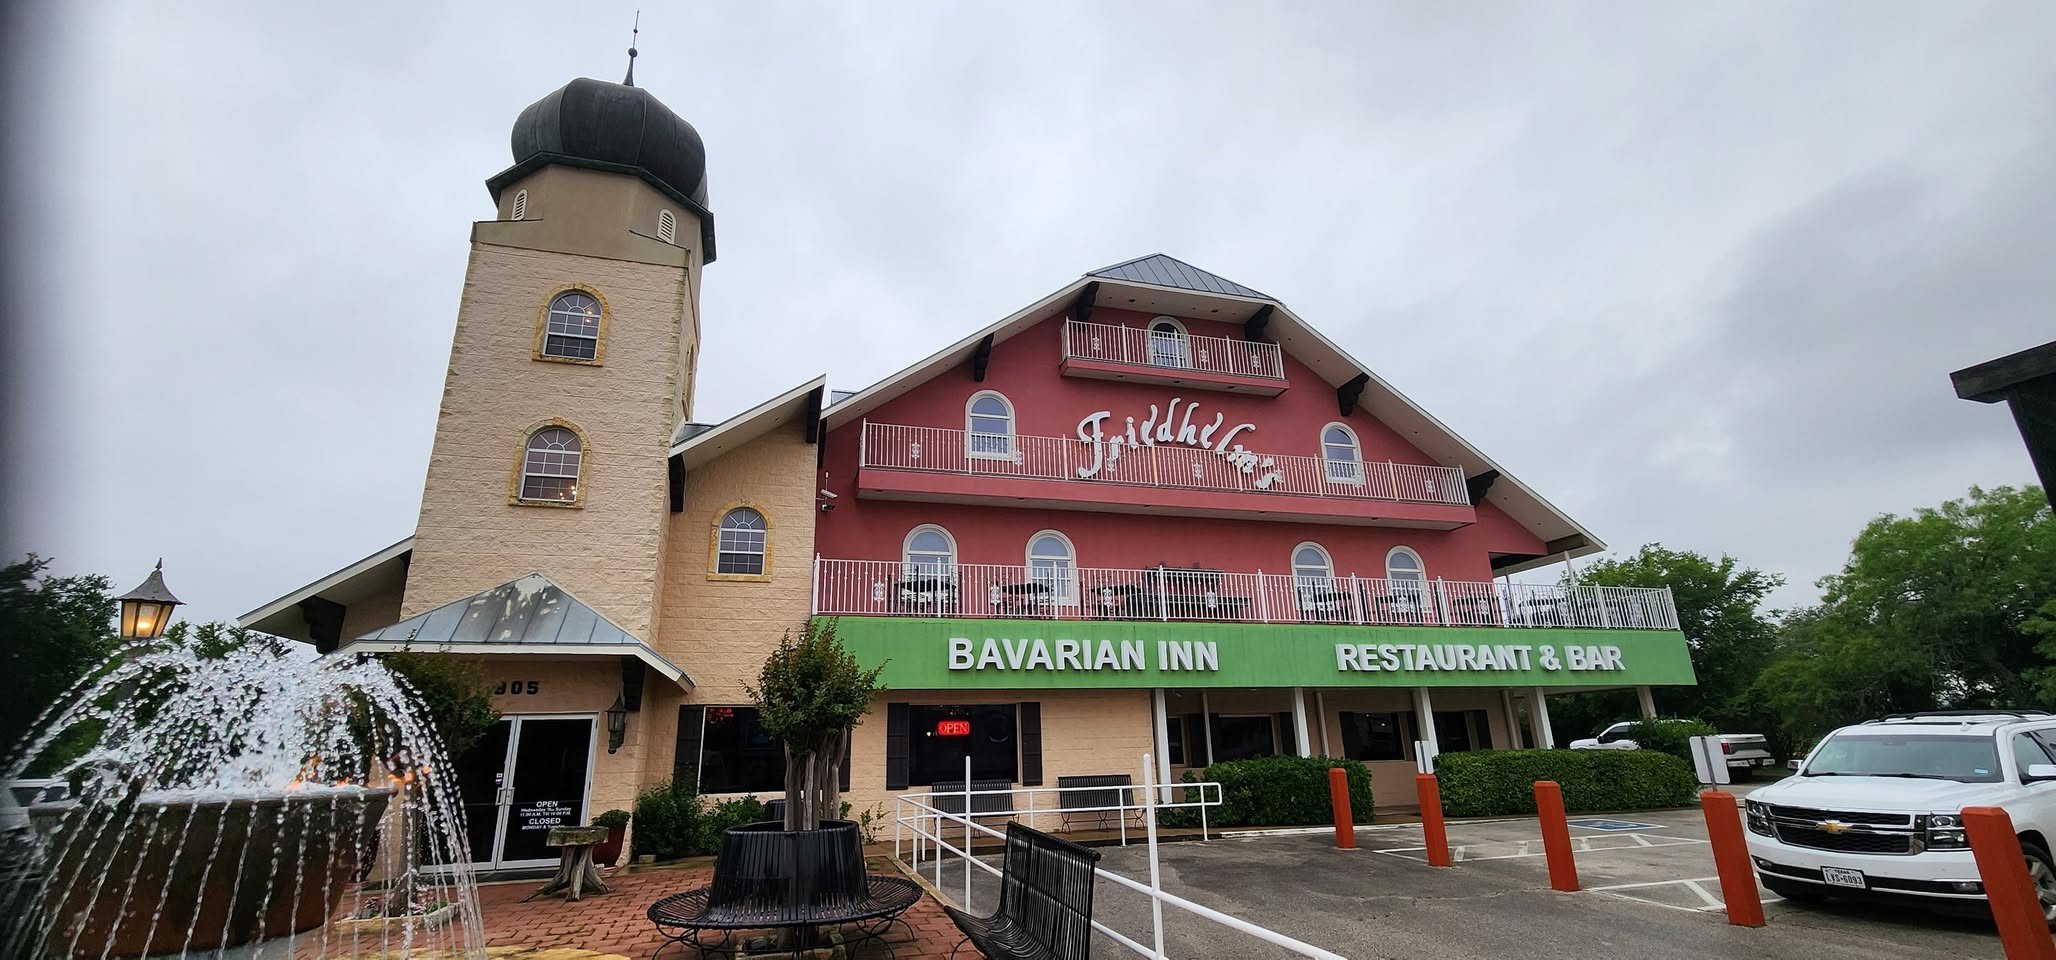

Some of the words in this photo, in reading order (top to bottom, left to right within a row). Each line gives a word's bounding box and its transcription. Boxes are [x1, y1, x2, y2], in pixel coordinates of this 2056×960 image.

[949, 637, 1146, 671] BAVARIAN
[1157, 640, 1219, 671] INN
[1335, 643, 1532, 671] RESTAURANT
[1539, 645, 1562, 671] &
[1563, 645, 1626, 671] BAR
[940, 722, 968, 734] OPEN
[528, 817, 561, 825] CLOSED
